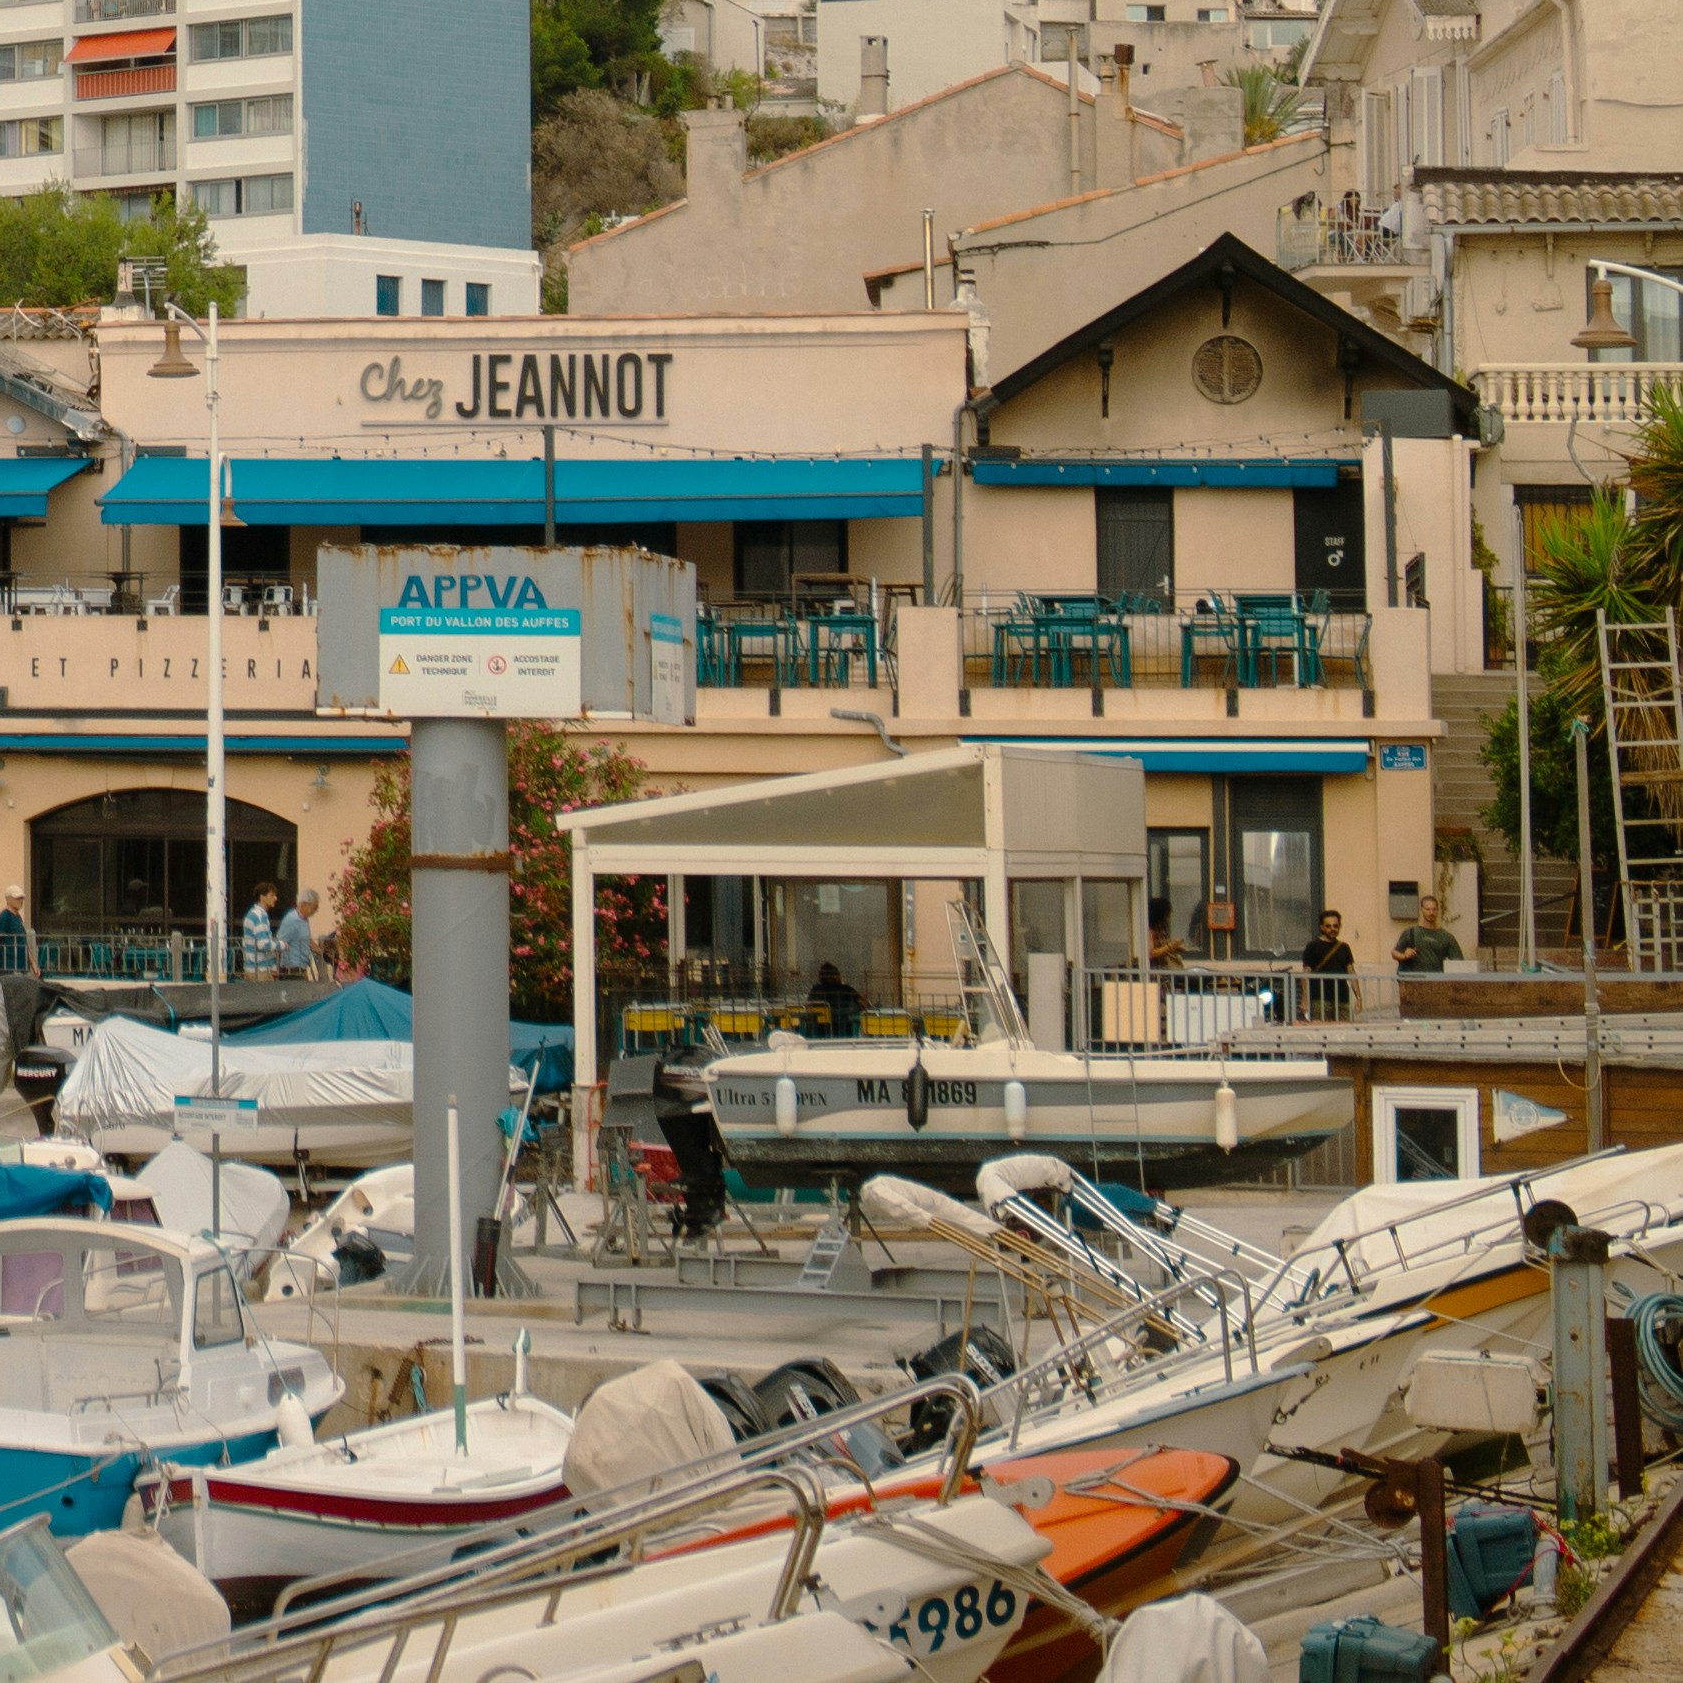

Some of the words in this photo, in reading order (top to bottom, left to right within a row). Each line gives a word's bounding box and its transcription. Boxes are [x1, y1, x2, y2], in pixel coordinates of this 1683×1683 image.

[360, 355, 444, 419] Chez
[455, 353, 673, 418] JEANNOT
[1324, 536, 1346, 547] STAFF
[397, 574, 548, 609] APPVA
[390, 615, 422, 627] PORT
[425, 616, 442, 627] DU
[445, 616, 492, 627] VALLON
[495, 617, 519, 628] DES
[522, 617, 569, 629] AUFFES
[416, 653, 450, 663] DANGER
[451, 654, 473, 664] ZONE
[513, 654, 560, 665] ACCOSTAGE
[30, 656, 69, 678] ET
[421, 666, 468, 676] TECHNIQUE
[517, 667, 556, 677] INTERDIT
[16, 1067, 58, 1079] MERCURY
[716, 1087, 756, 1107] Ultra
[856, 1079, 891, 1104] MA
[901, 1080, 978, 1105] 81869
